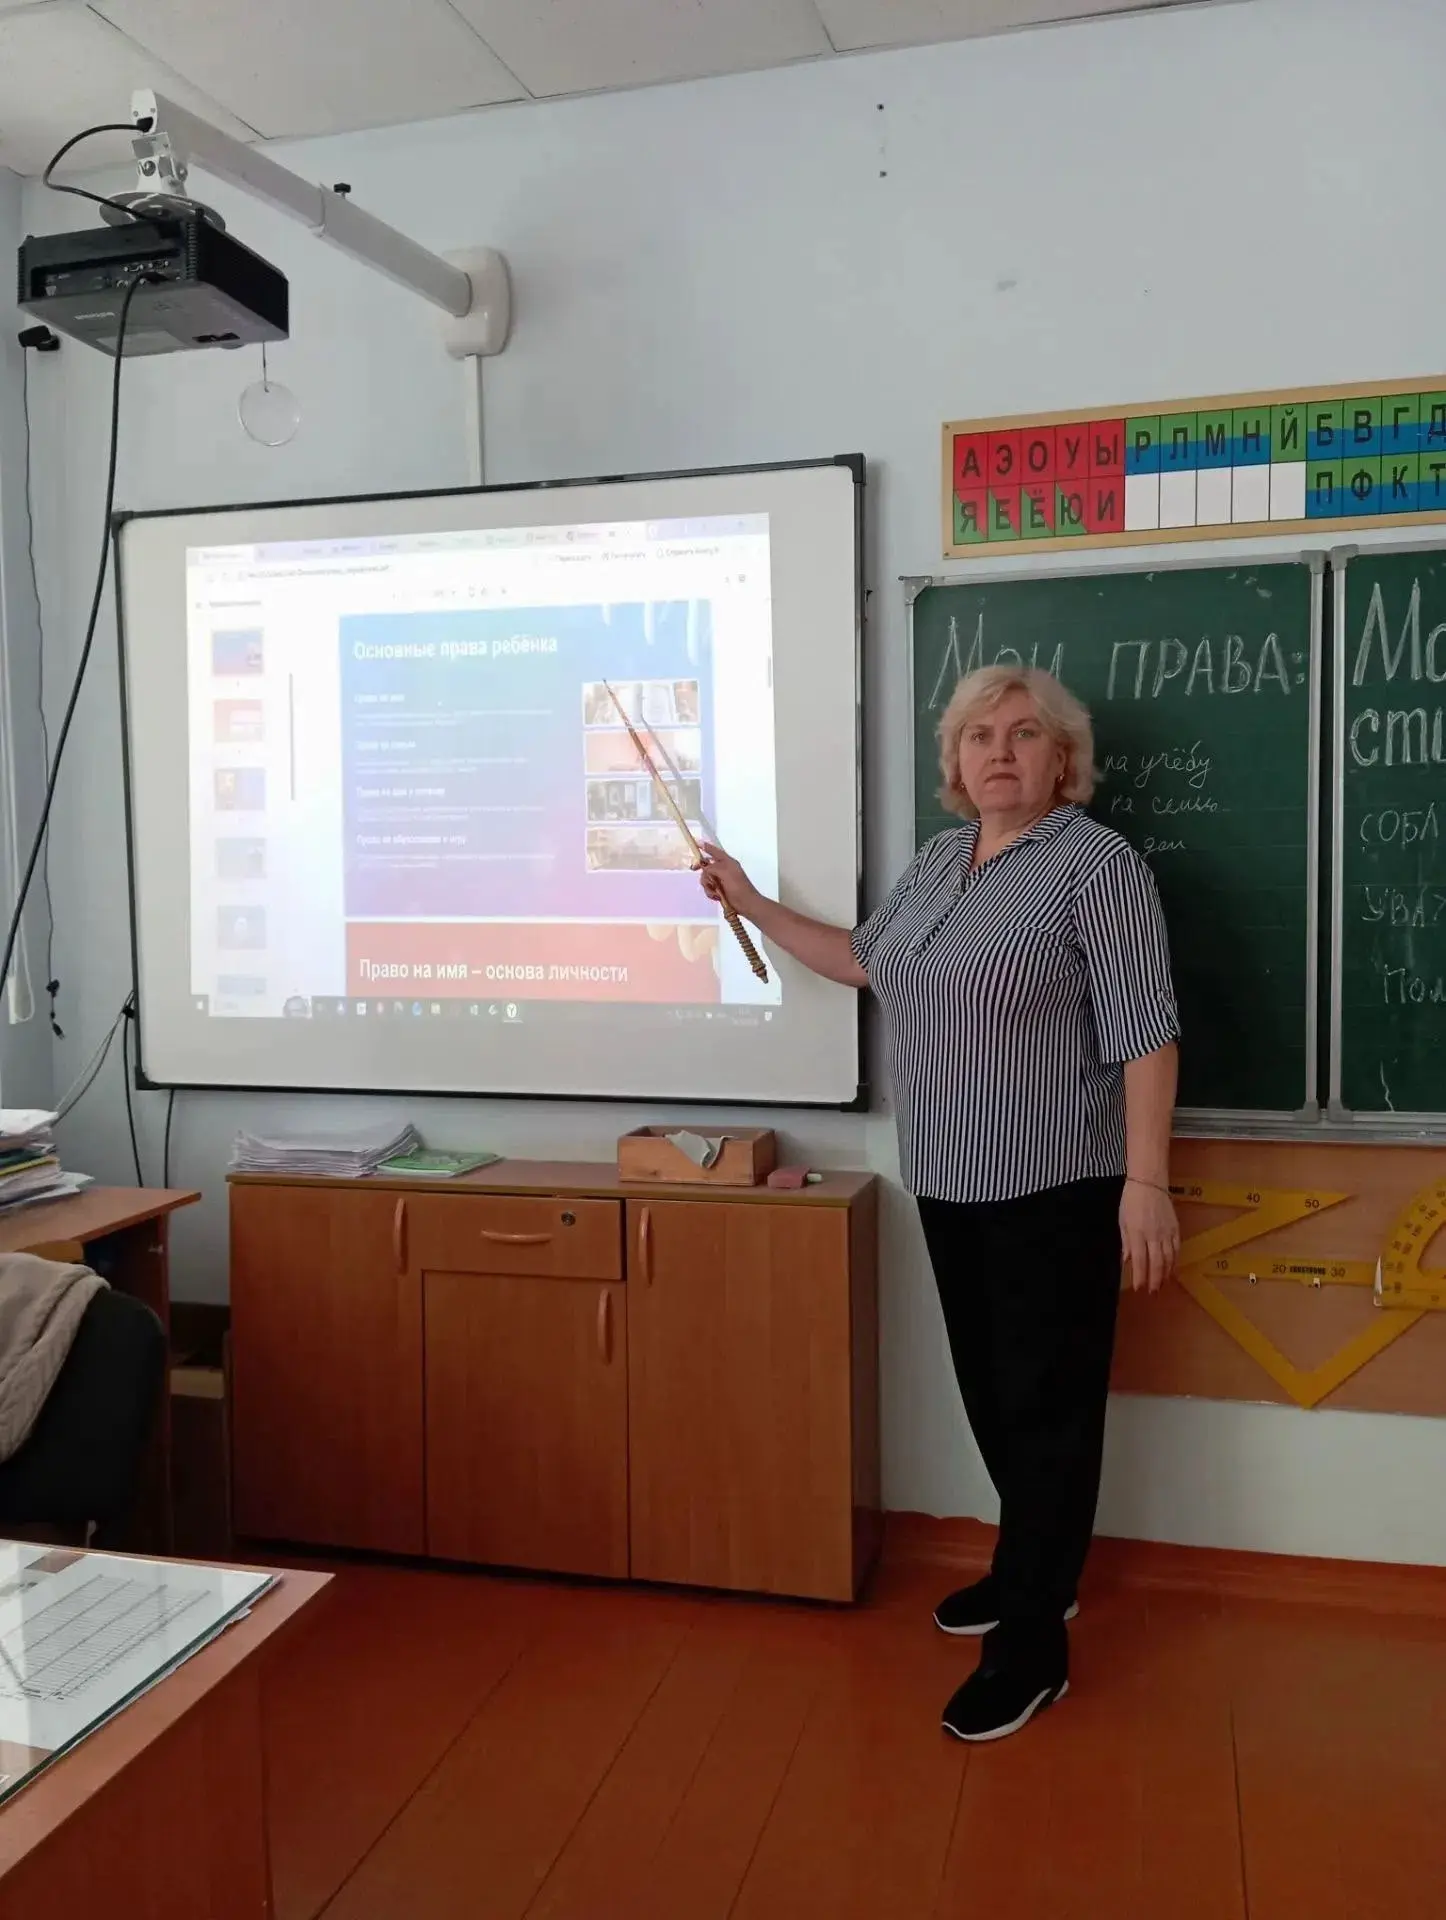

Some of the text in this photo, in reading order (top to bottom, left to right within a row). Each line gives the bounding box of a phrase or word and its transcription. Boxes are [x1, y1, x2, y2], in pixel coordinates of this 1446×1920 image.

[961, 447, 981, 479] А
[995, 443, 1013, 476] Э
[1028, 440, 1048, 472] О
[1065, 435, 1081, 469] У
[1095, 433, 1118, 467] Ы
[1135, 430, 1151, 463] Р
[1169, 426, 1188, 461] Л
[1205, 423, 1226, 457] М
[1242, 419, 1261, 453] Н
[1280, 407, 1298, 451] Й
[1316, 413, 1334, 447] Б
[1353, 409, 1373, 444] В
[1393, 406, 1410, 440] Г
[1316, 462, 1446, 505] П Ф К Т
[960, 489, 1115, 534] Я Е Ё Ю И
[354, 633, 559, 662] Основные права ребёнка
[1106, 632, 1306, 701] ПРАВА:
[1134, 740, 1213, 789] учёбу
[359, 958, 409, 982] Право
[413, 961, 432, 979] на
[436, 962, 468, 979] имя
[485, 962, 545, 981] основа
[548, 963, 629, 983] личности
[1246, 1191, 1261, 1204] 40
[1304, 1198, 1320, 1209] 50
[1216, 1259, 1229, 1271] 10
[1271, 1263, 1287, 1275] 20
[1330, 1266, 1346, 1278] 30
